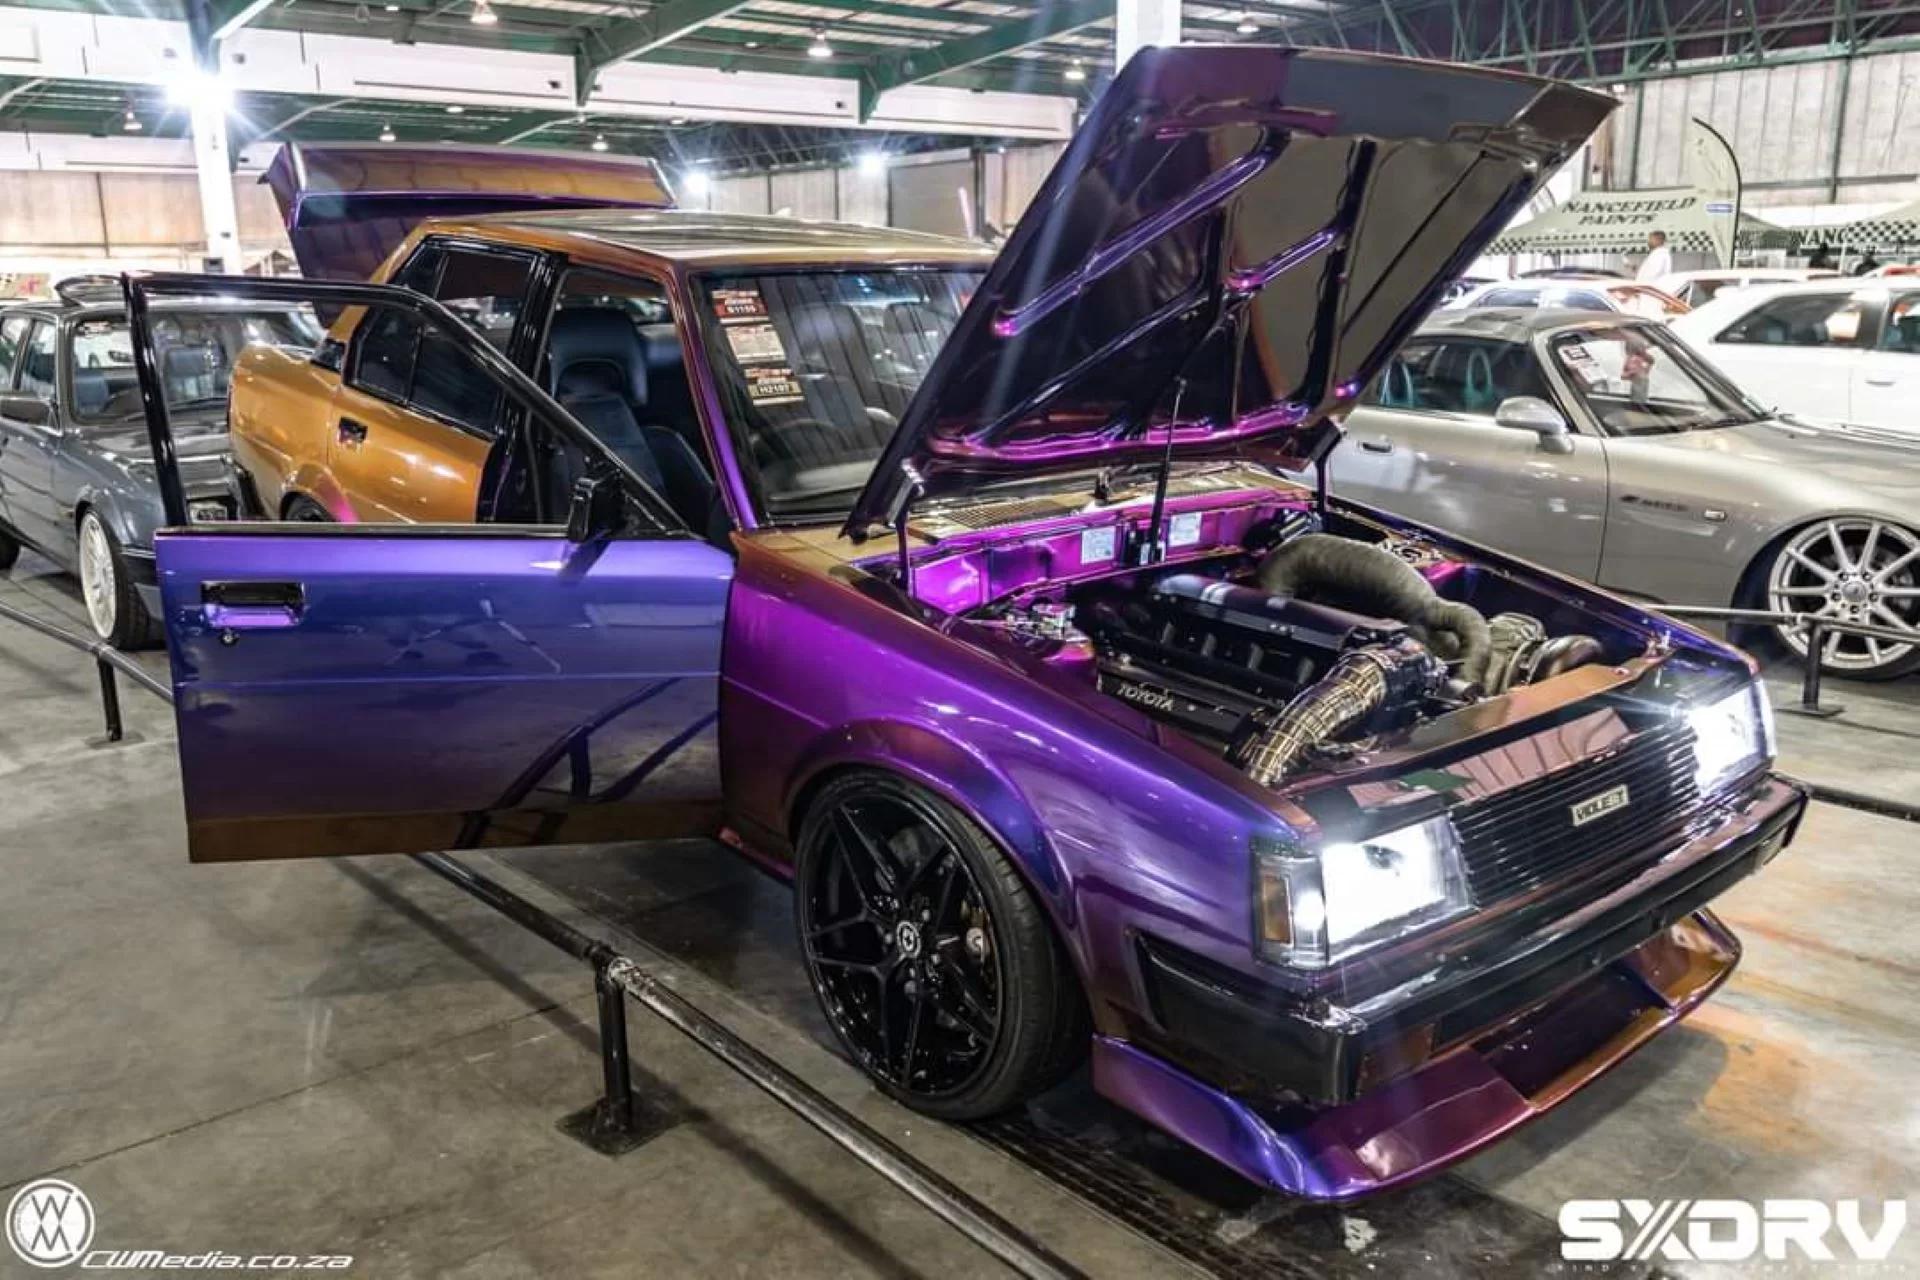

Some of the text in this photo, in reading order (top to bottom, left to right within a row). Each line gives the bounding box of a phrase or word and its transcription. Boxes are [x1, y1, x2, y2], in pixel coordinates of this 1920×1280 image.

[1562, 197, 1697, 213] NANCEFIELD
[1578, 213, 1657, 225] PAINTS
[1117, 682, 1174, 712] TOYOTA
